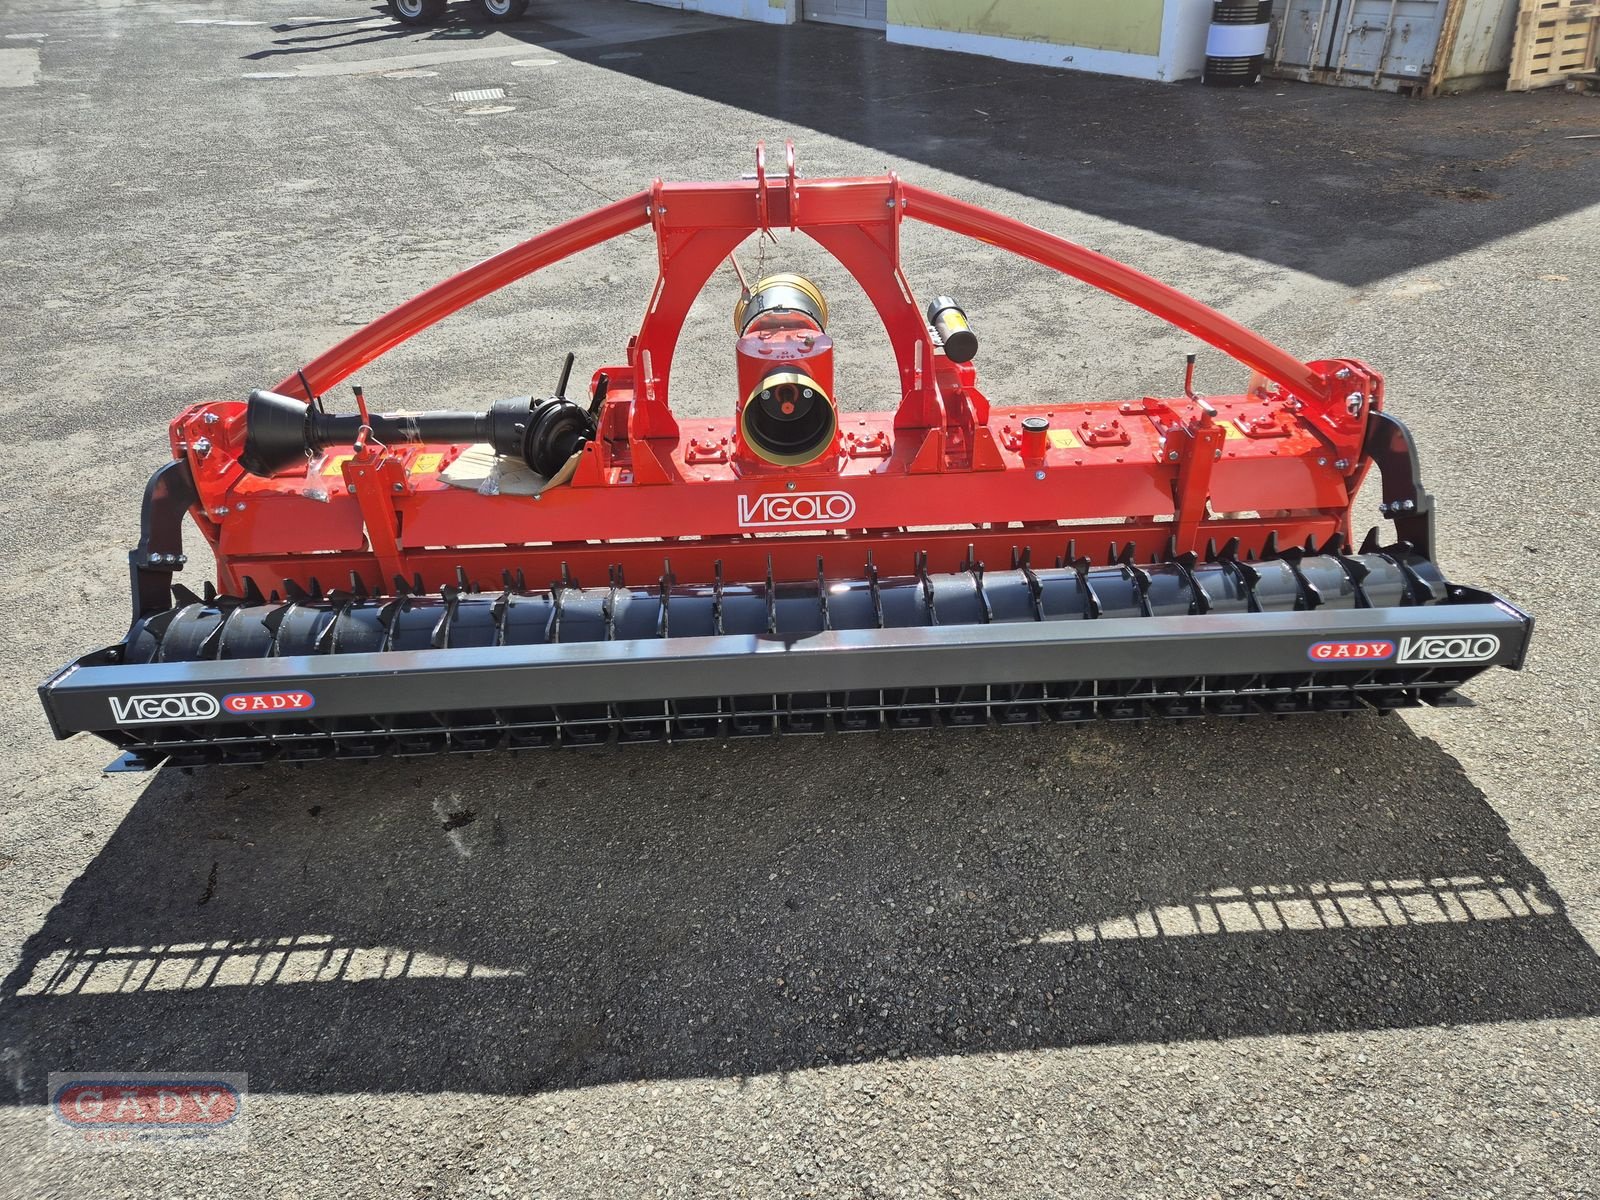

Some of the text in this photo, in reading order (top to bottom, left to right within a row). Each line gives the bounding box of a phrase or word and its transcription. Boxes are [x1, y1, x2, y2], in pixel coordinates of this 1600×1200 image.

[737, 490, 857, 527] VIGOLO
[1315, 643, 1388, 659] GADY
[1396, 633, 1500, 664] VIGOLO
[108, 691, 220, 724] VIGOLO
[230, 692, 306, 711] GADY
